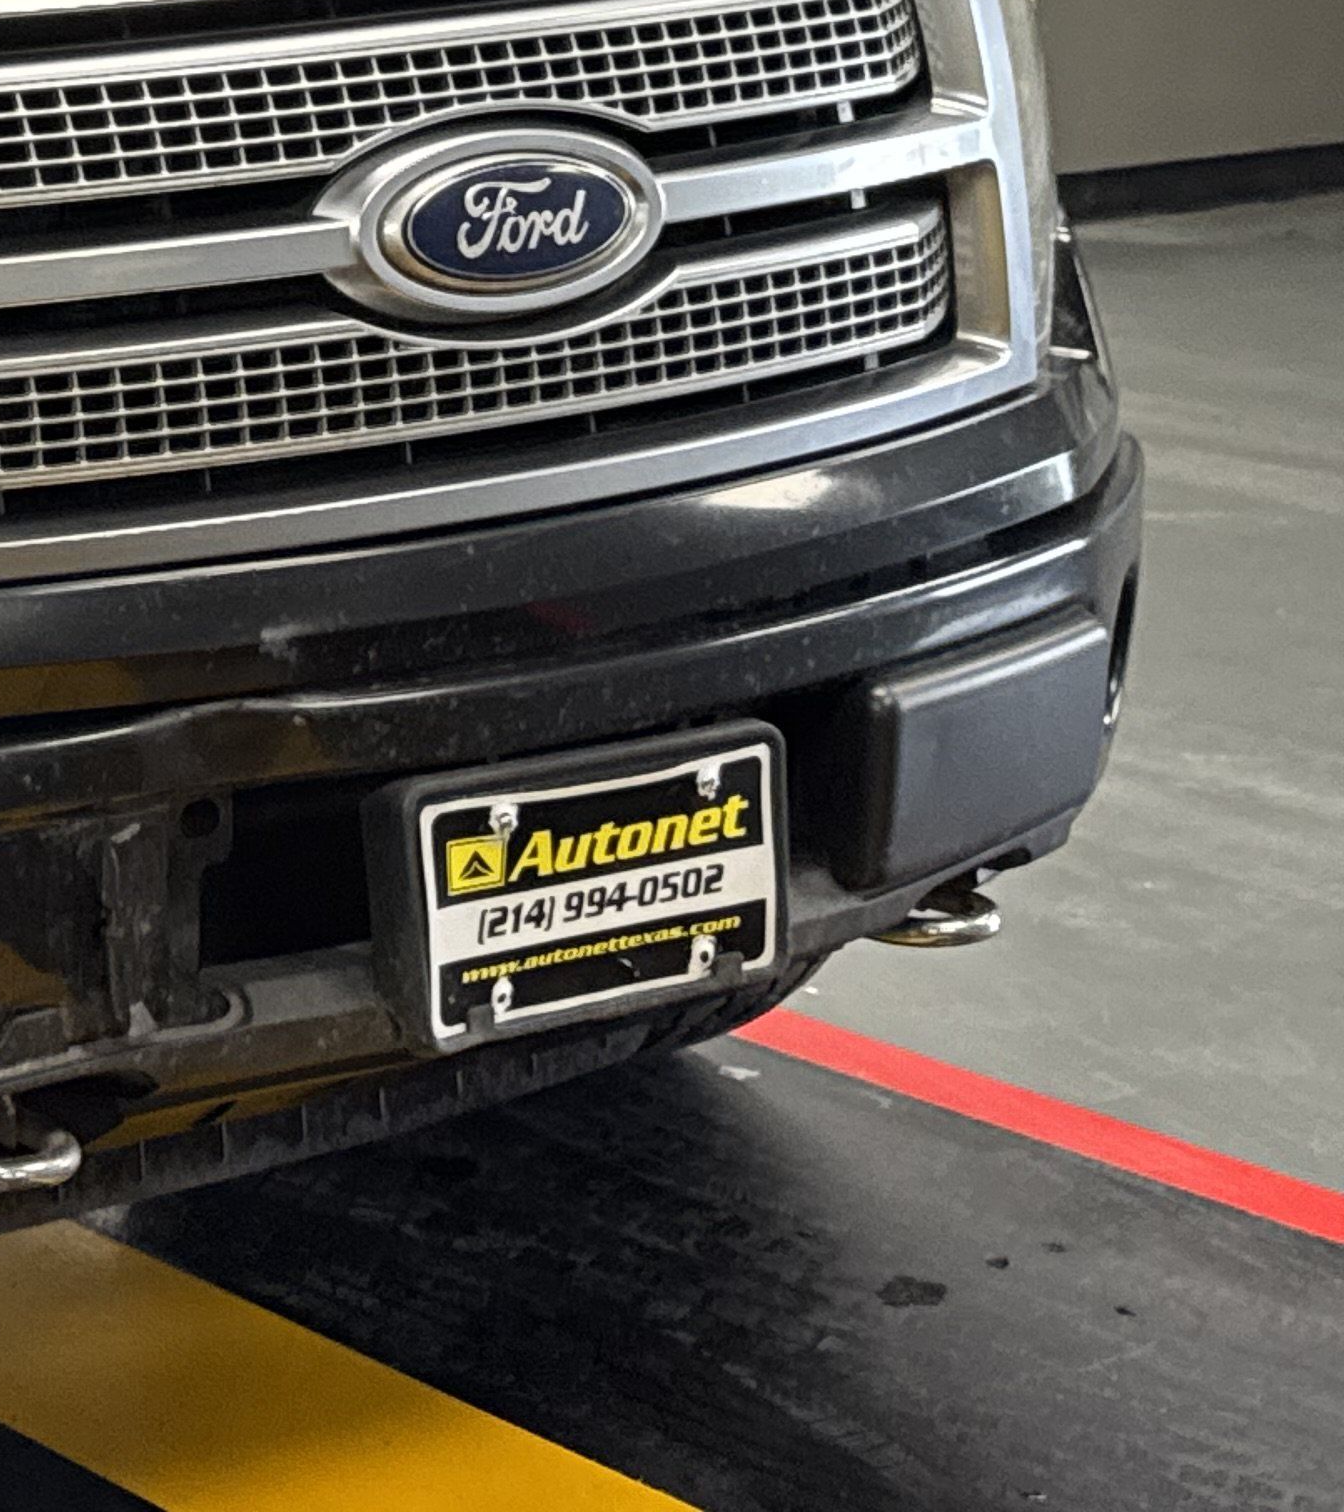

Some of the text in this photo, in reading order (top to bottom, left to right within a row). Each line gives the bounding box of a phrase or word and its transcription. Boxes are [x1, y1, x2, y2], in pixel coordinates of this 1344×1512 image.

[456, 176, 590, 260] Ford
[508, 793, 750, 882] Autonet
[476, 863, 725, 945] (214) 994-0502
[461, 914, 742, 984] www.autonettexas.com
